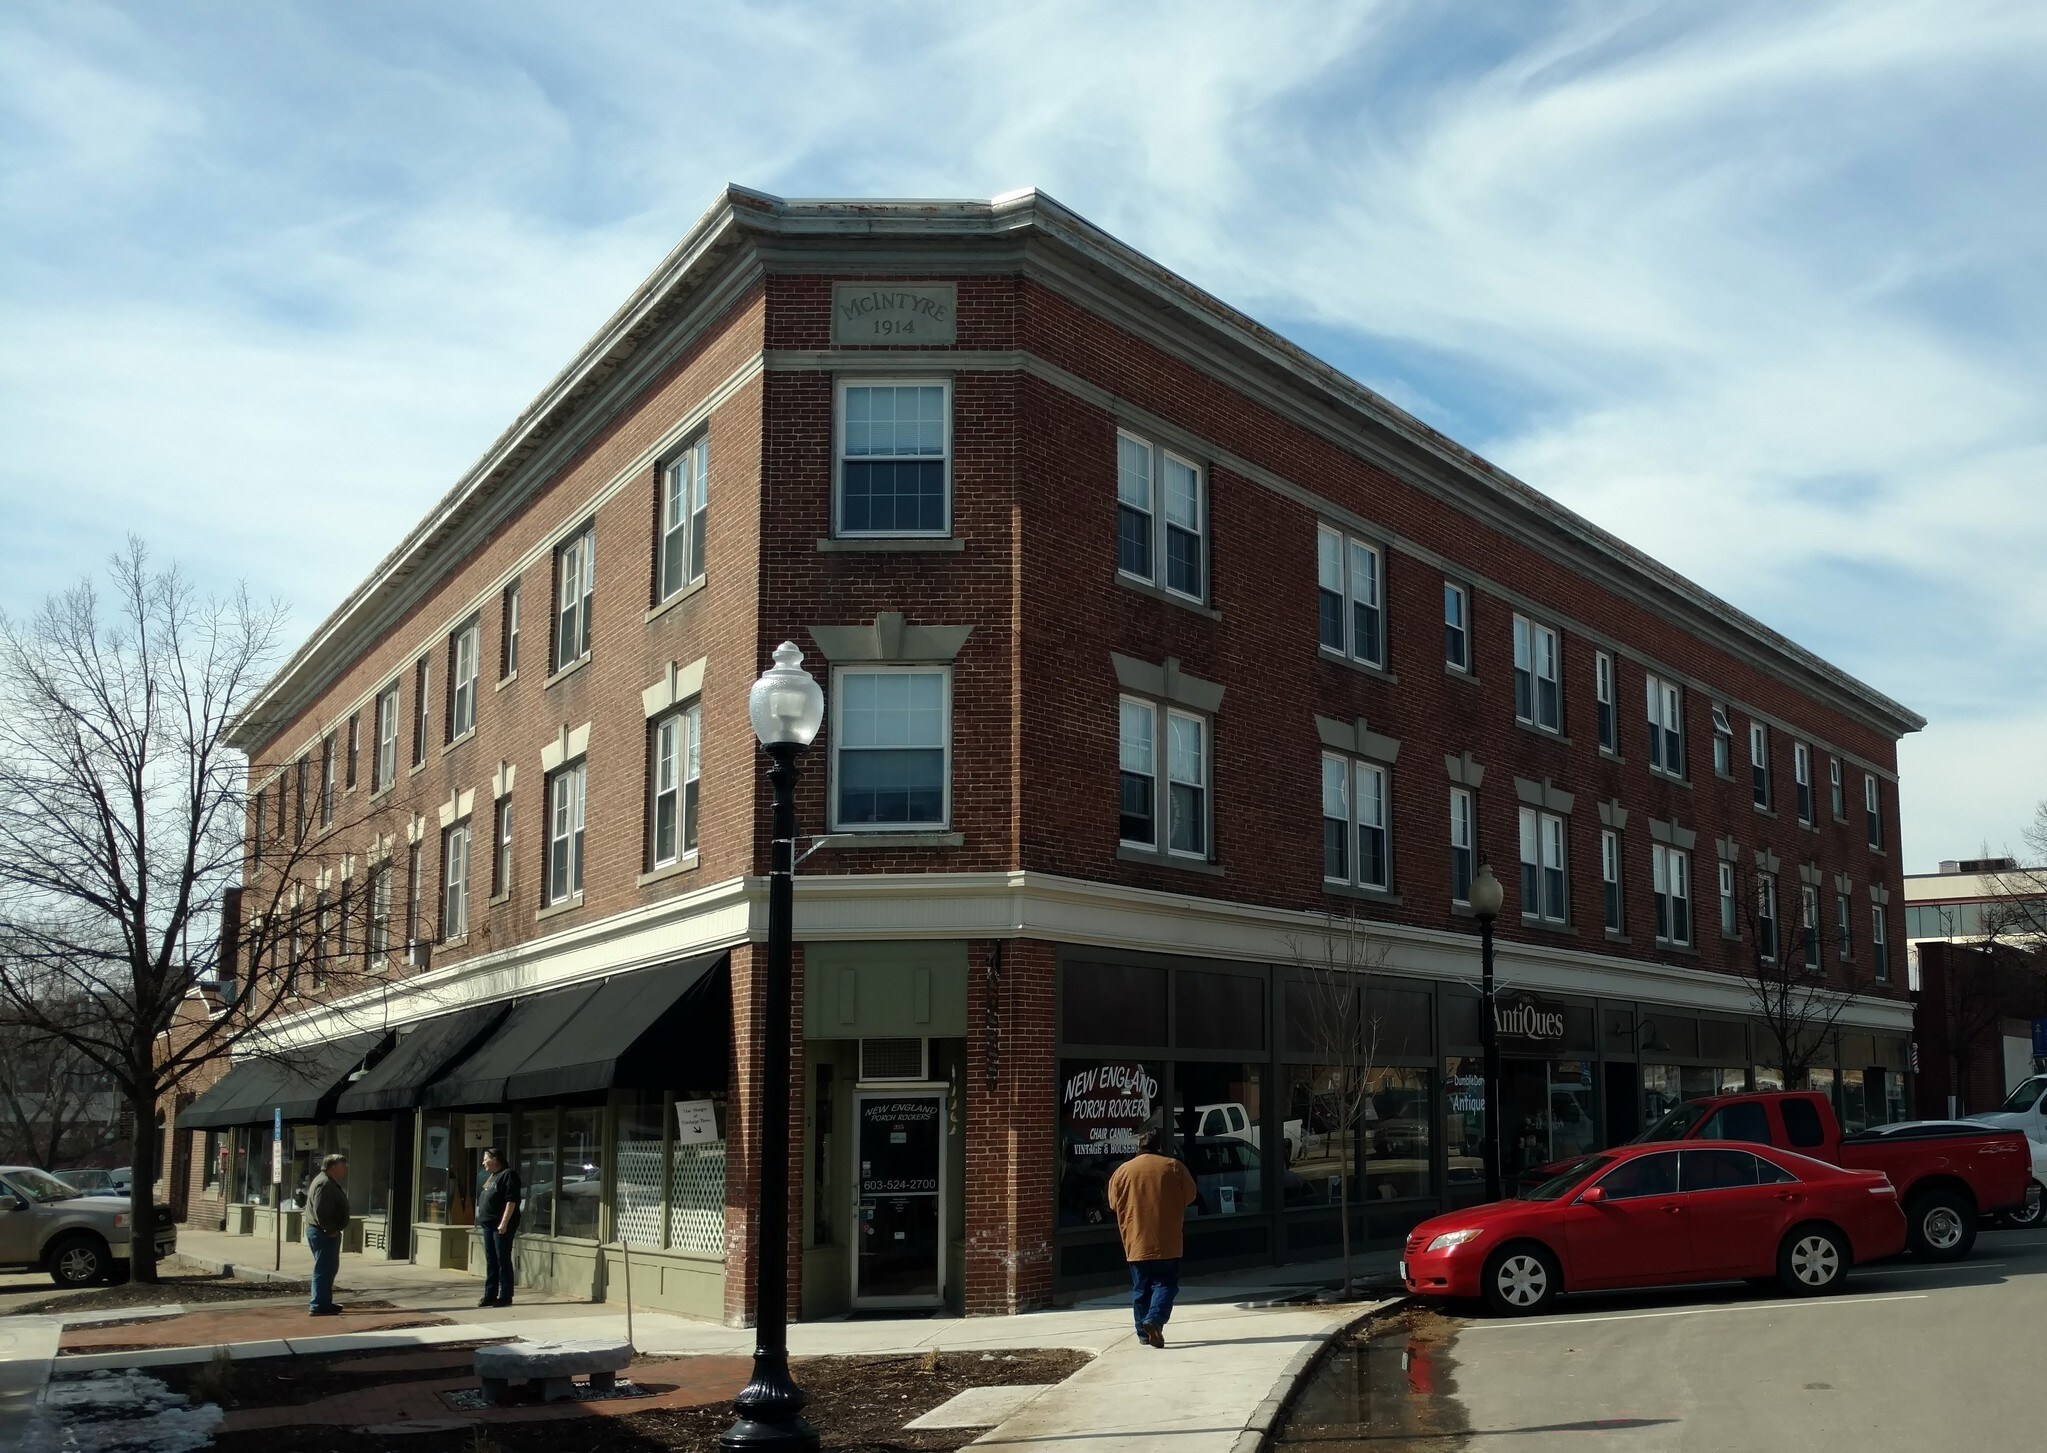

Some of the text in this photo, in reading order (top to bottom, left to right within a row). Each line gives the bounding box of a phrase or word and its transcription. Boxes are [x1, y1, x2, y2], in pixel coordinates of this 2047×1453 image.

[840, 292, 948, 322] MCINTYRE
[874, 320, 916, 336] 1914
[1064, 1066, 1158, 1104] NEW ENGLAND
[865, 1104, 937, 1116] NEW ENGLAND
[1072, 1099, 1107, 1120] PORCH
[1453, 1095, 1485, 1116] Antique
[871, 1113, 932, 1122] PORCH ROCKERS
[1089, 1127, 1108, 1140] CHAIR
[1074, 1144, 1103, 1155] VINTAGE
[1103, 1143, 1109, 1155] &
[864, 1180, 935, 1190] 603-524-2700
